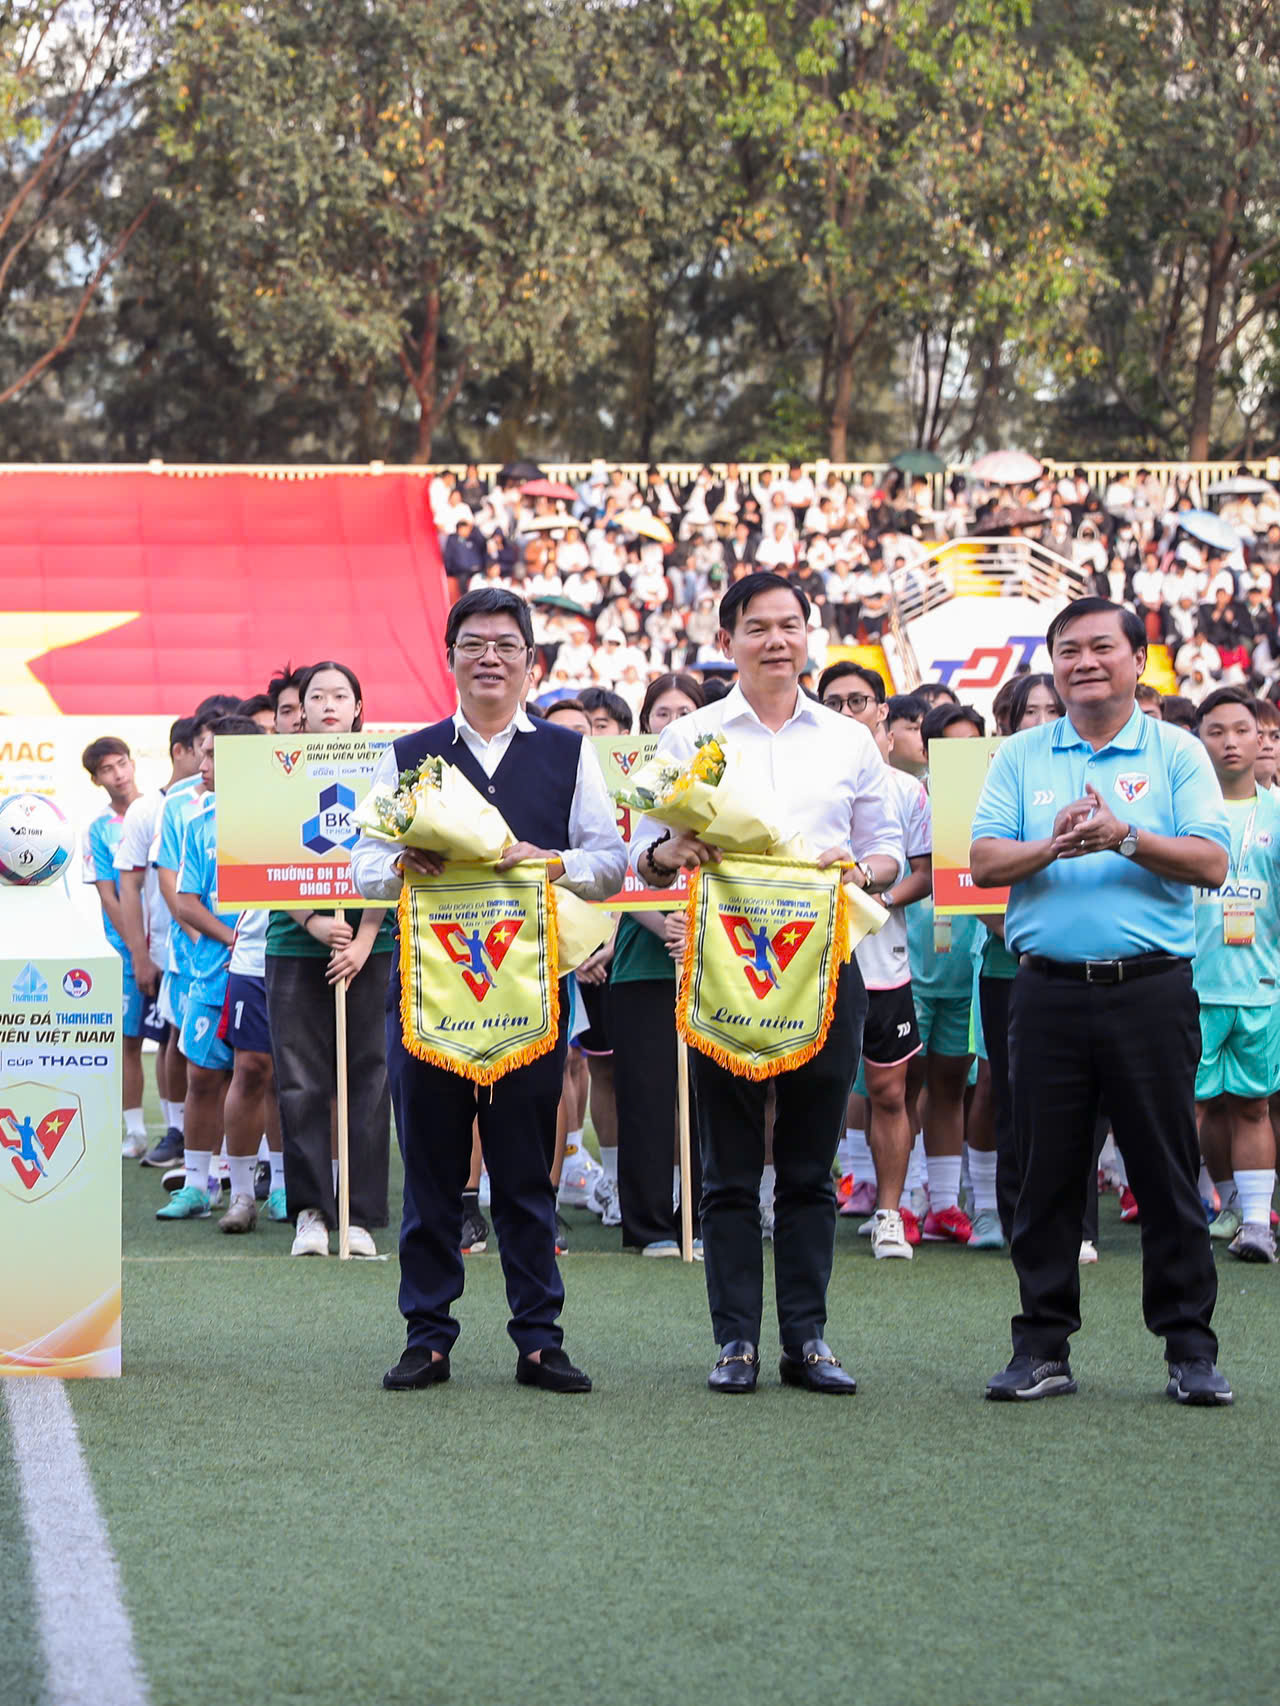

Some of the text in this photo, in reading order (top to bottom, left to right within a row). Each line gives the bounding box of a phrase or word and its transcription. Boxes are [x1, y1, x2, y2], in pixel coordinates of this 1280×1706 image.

[325, 813, 350, 827] BK
[267, 865, 314, 881] TRƯỜNG
[317, 867, 333, 880] ĐH
[504, 909, 526, 917] NAM
[719, 904, 741, 912] SINH
[795, 911, 818, 919] NAM
[30, 1010, 52, 1025] ĐÁ
[234, 1001, 244, 1030] 1
[482, 1013, 529, 1031] niệm
[194, 1016, 210, 1042] 9
[760, 1016, 804, 1033] niệm
[36, 1027, 71, 1046] VIỆT
[75, 1031, 115, 1043] NAM
[7, 1057, 34, 1066] CÚP
[38, 1055, 108, 1067] THACO
